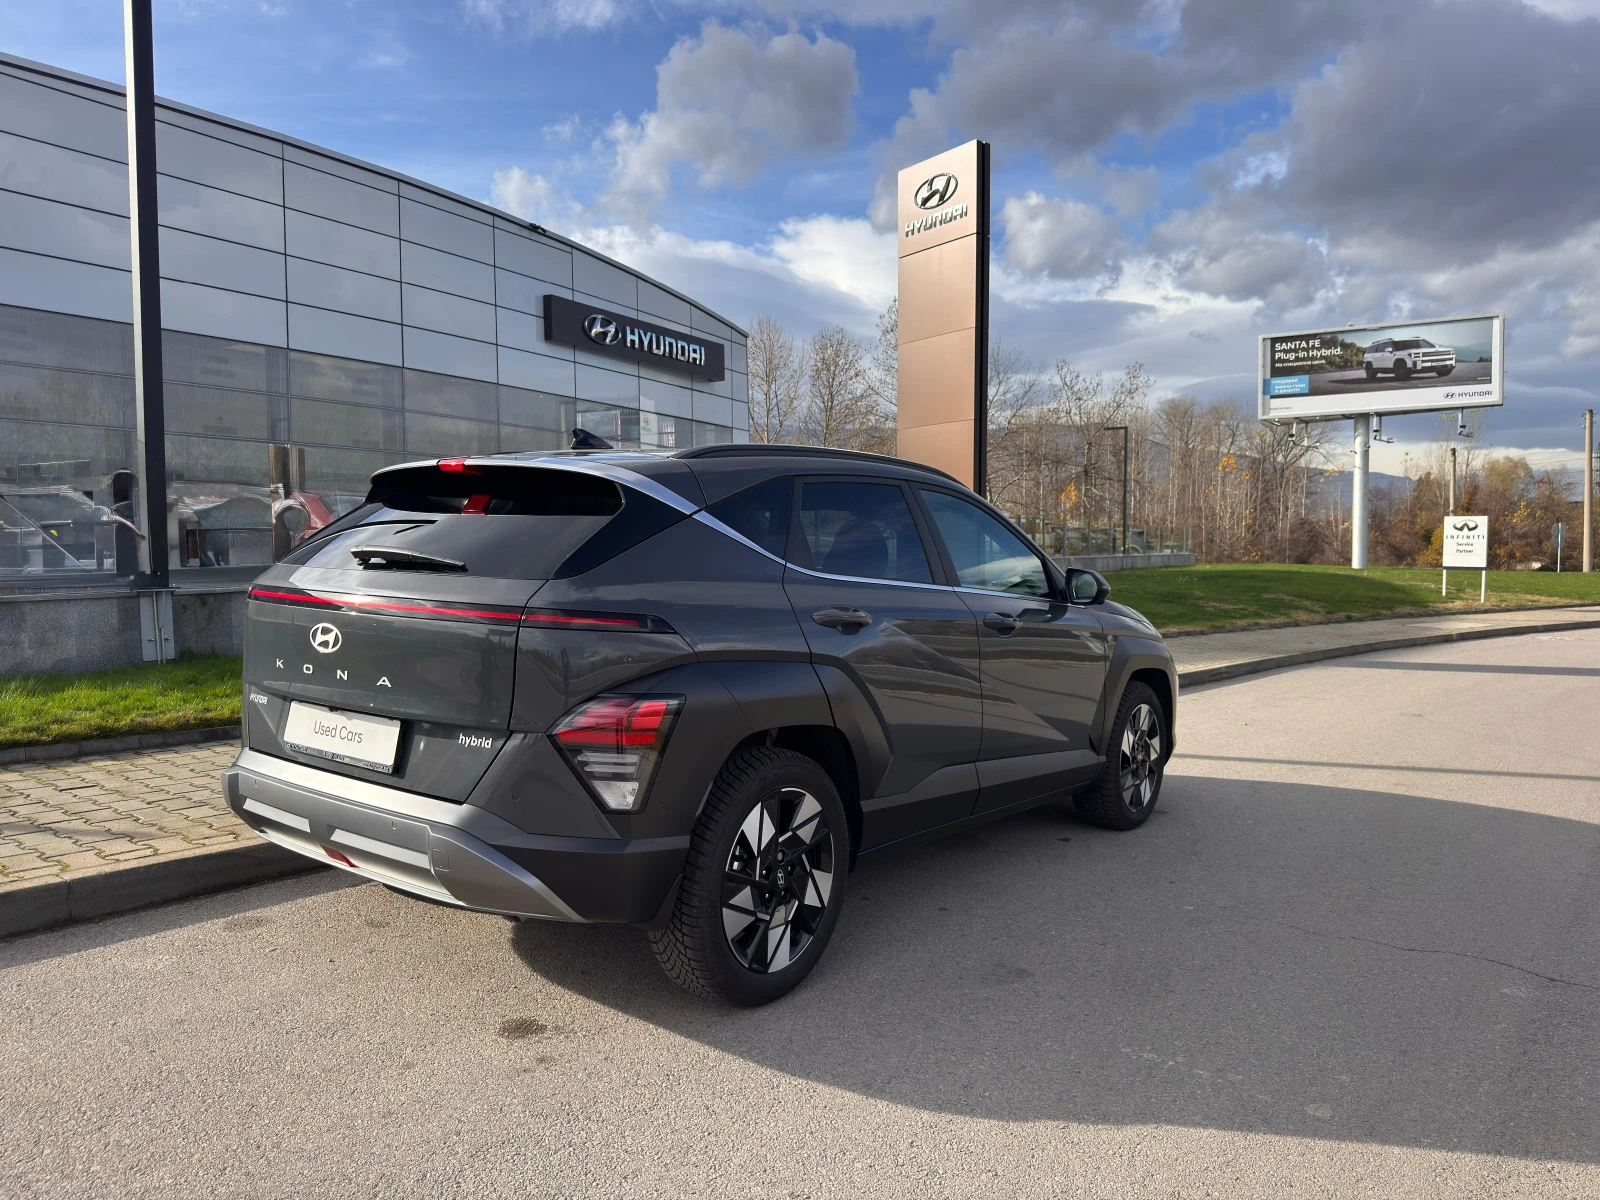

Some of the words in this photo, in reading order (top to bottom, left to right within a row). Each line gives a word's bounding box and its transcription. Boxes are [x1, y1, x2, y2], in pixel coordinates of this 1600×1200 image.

[904, 200, 968, 238] HYUNDAI
[625, 326, 706, 366] HYUNDAI
[1274, 341, 1307, 350] SANTA
[1309, 340, 1320, 348] FE
[1275, 350, 1308, 360] Plug-in
[1310, 347, 1342, 358] Hybrid.
[276, 658, 392, 688] KONA
[313, 720, 336, 738] Used
[339, 726, 364, 744] Cars
[458, 733, 493, 749] hybrid
